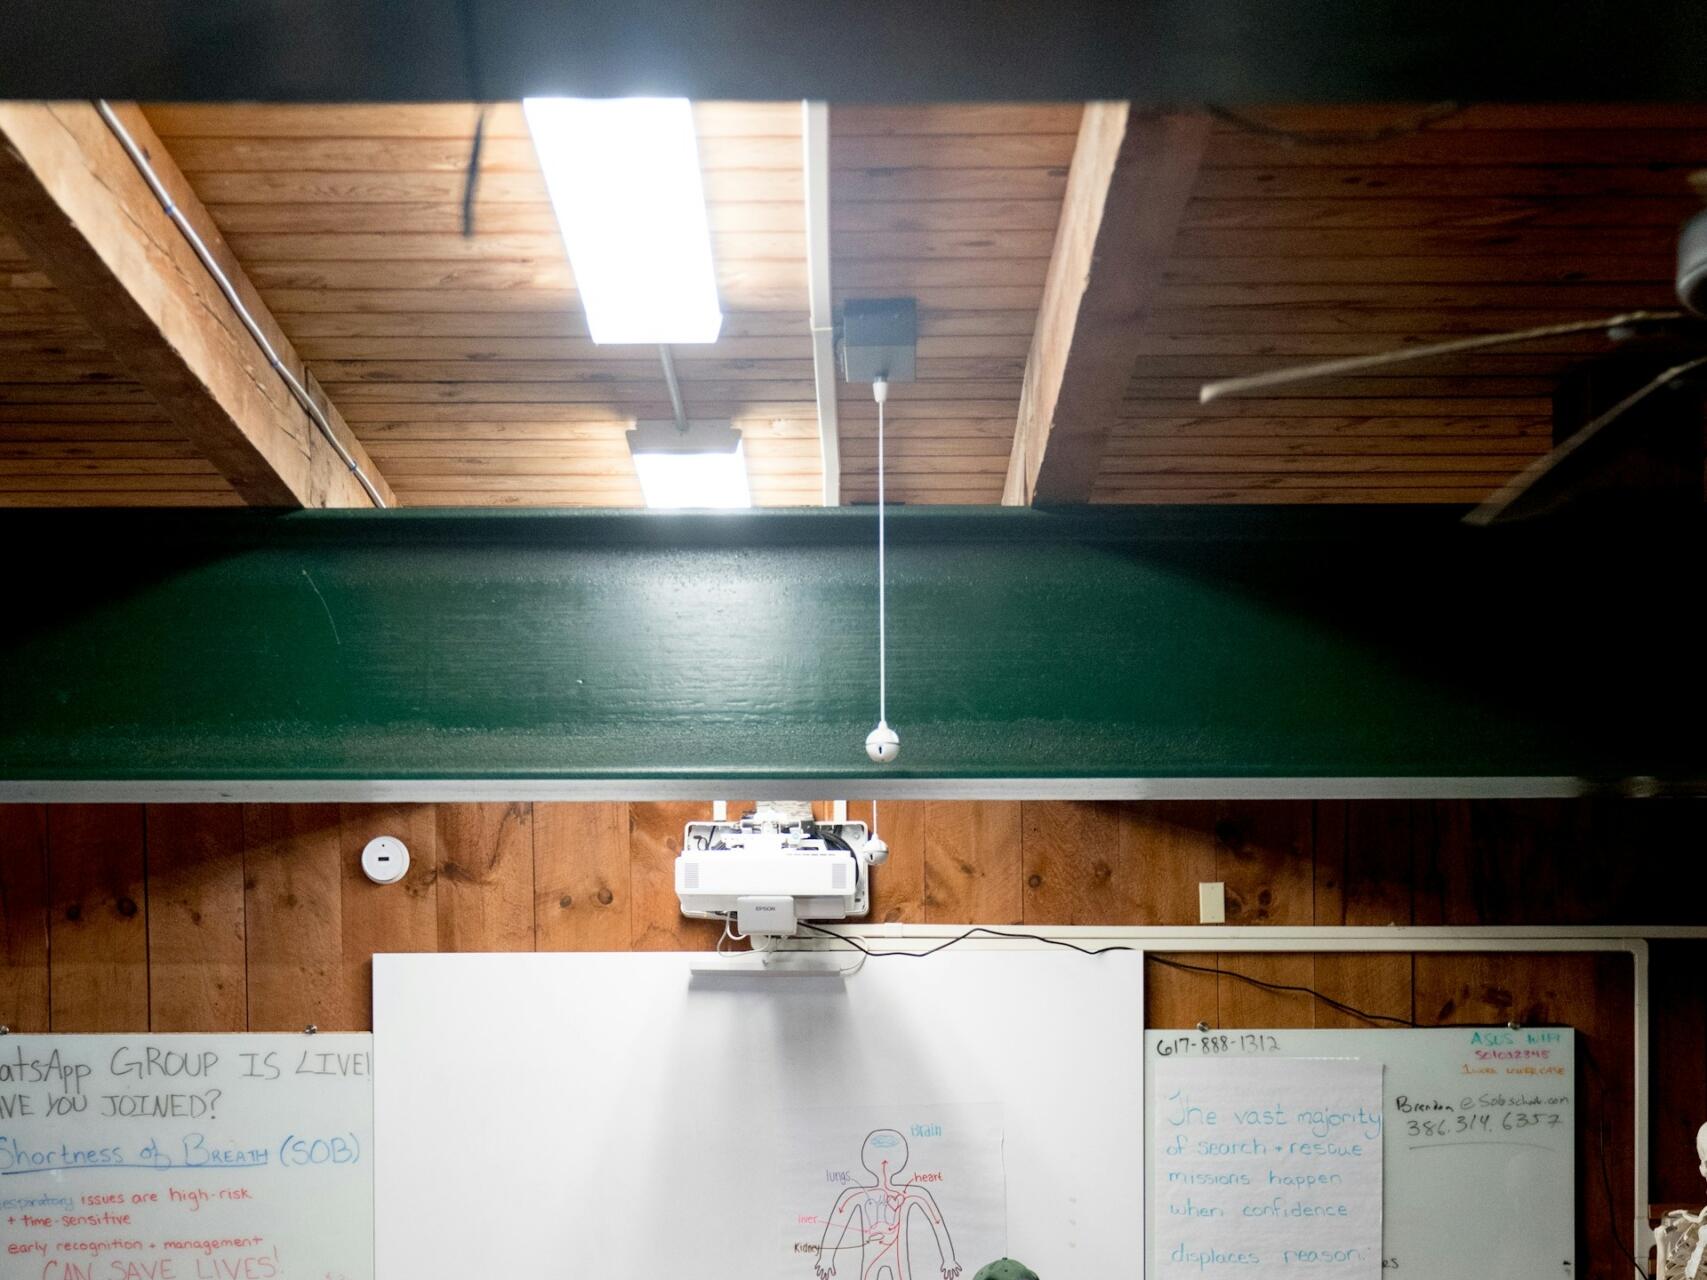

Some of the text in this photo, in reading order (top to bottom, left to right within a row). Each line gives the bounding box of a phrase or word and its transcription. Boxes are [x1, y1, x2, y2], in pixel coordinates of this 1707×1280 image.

[1156, 1035, 1281, 1056] 617-888-1312
[110, 1047, 219, 1080] GROUP
[239, 1051, 281, 1080] IS
[295, 1050, 371, 1082] LIVE!
[46, 1092, 88, 1117] YOU
[101, 1089, 222, 1119] JOINED?
[1234, 1103, 1288, 1126] vast
[1297, 1105, 1382, 1140] majority
[139, 1137, 172, 1171] of
[280, 1132, 360, 1168] (SOB)
[1166, 1134, 1188, 1156] of
[1197, 1137, 1267, 1157] search
[1289, 1141, 1363, 1157] rescue
[826, 1169, 851, 1185] lungs
[914, 1172, 943, 1182] heart
[1168, 1169, 1342, 1189] missions happen
[81, 1192, 124, 1206] issues
[131, 1191, 158, 1204] are
[1169, 1197, 1348, 1218] when confidence
[8, 1240, 48, 1257] early
[56, 1238, 143, 1257] recognition
[164, 1236, 264, 1257] management
[1170, 1242, 1260, 1272] displaces
[196, 1245, 286, 1280] LIVES!
